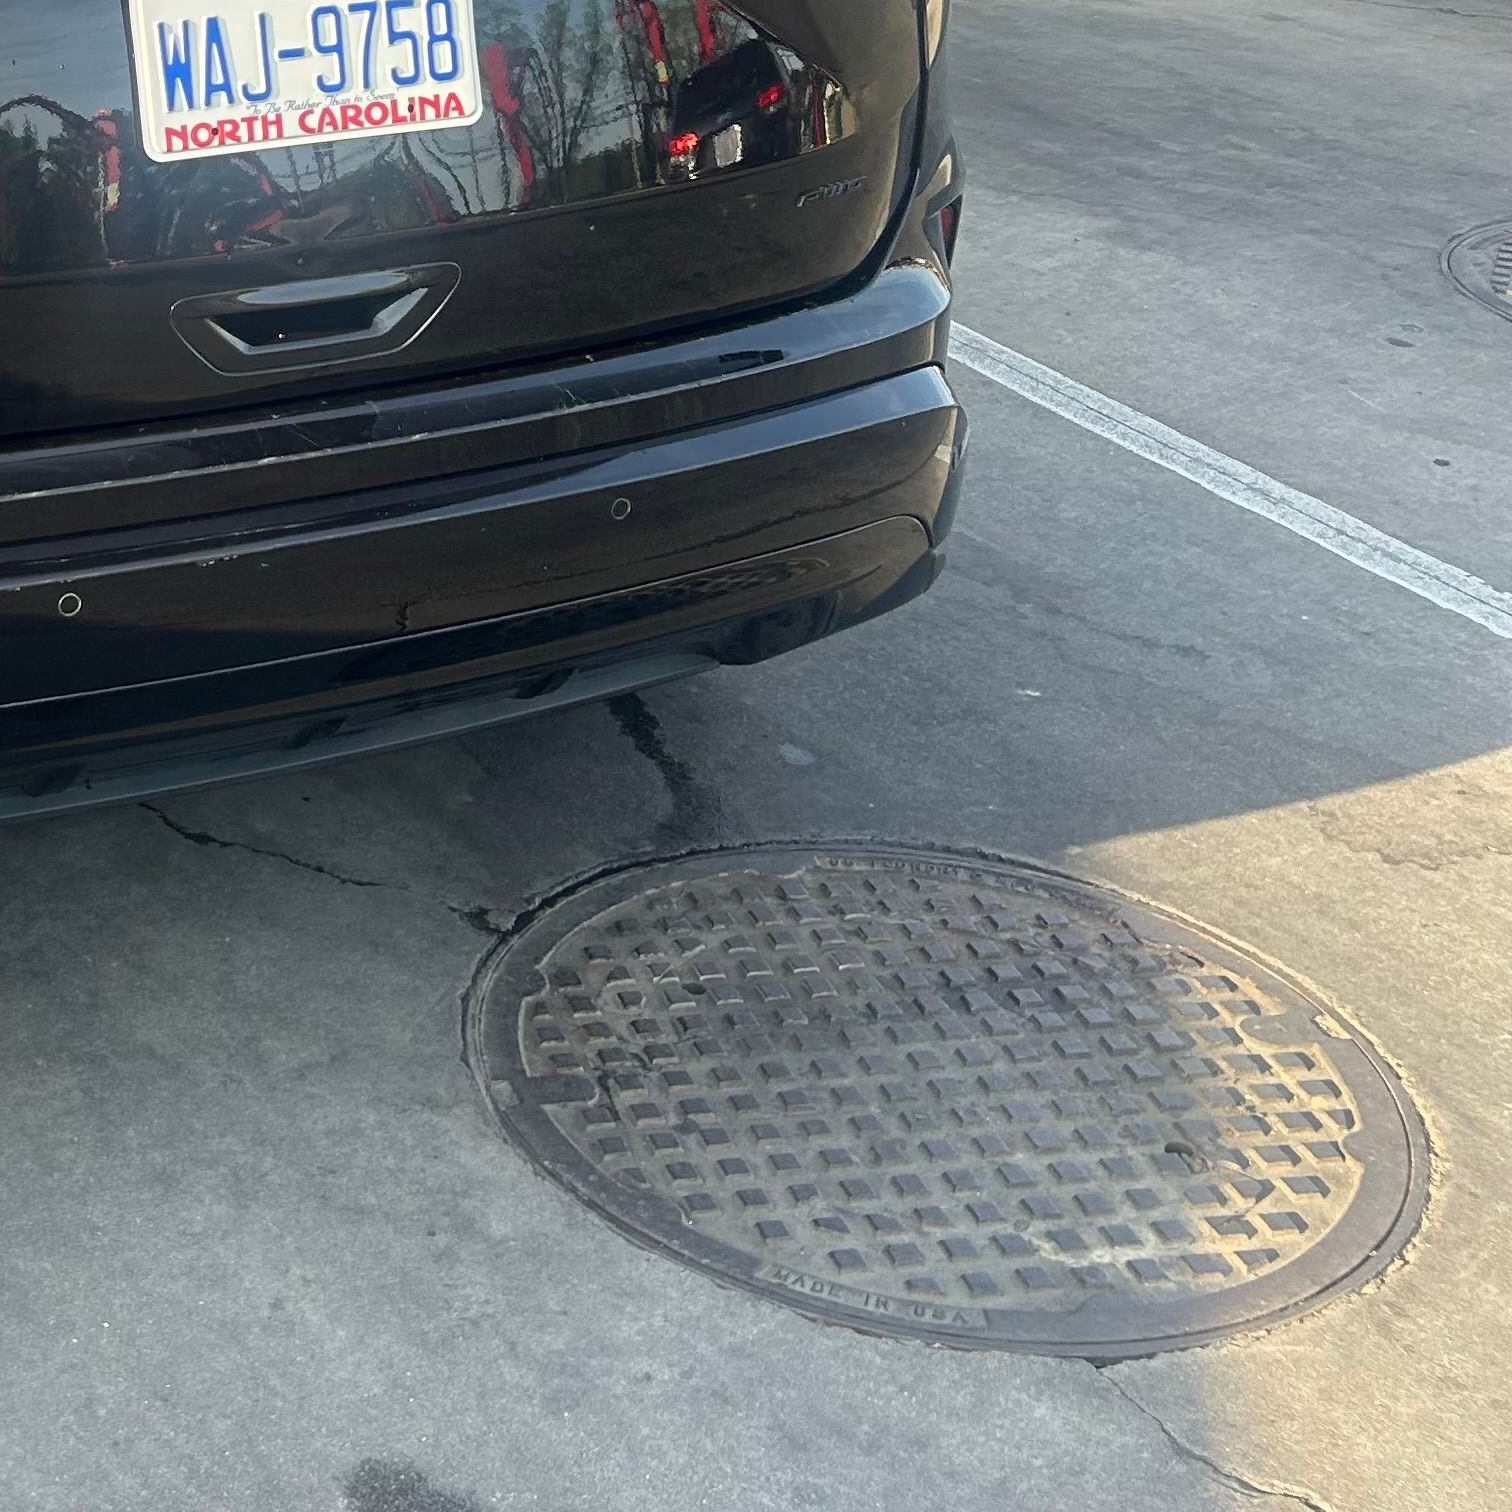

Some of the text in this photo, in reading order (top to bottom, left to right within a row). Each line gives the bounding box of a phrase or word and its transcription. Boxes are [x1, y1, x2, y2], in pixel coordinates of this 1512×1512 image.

[164, 91, 466, 153] NORTH CAROLINA
[771, 1267, 968, 1325] MADE IN USA
